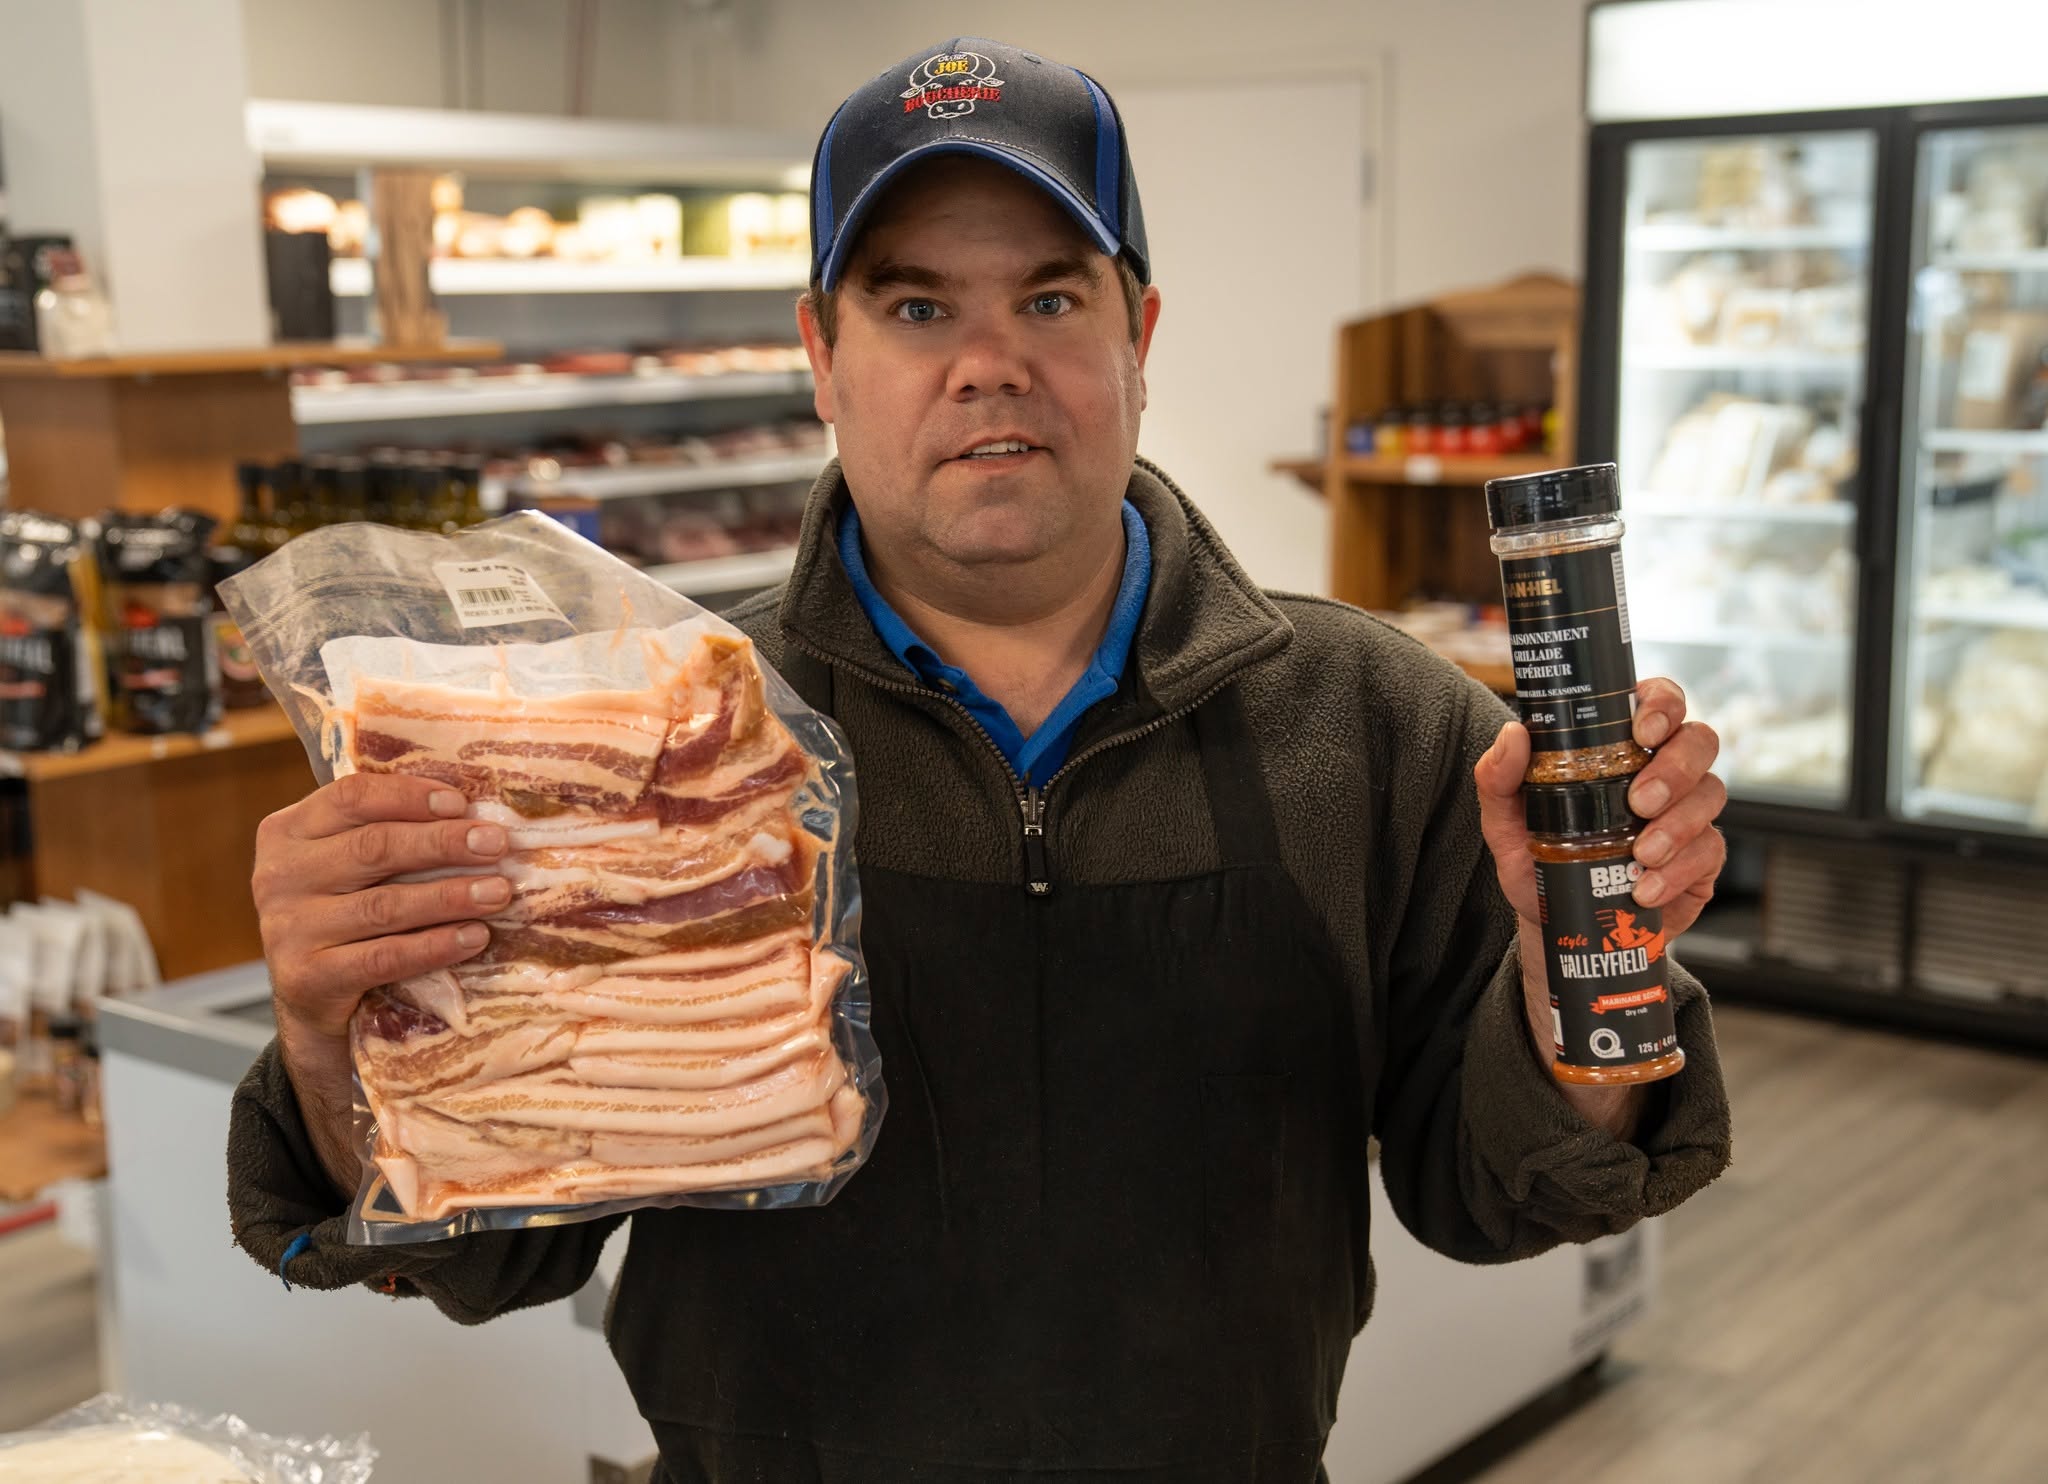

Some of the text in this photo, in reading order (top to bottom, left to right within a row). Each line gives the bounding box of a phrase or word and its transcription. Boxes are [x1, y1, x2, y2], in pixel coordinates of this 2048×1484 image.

[934, 60, 969, 75] JOE
[904, 85, 1001, 113] BOUCHERIE
[1514, 647, 1563, 662] GRILLADE
[1515, 664, 1573, 679] SUPÉRIEUR
[1547, 684, 1592, 696] SEASONING
[1532, 712, 1544, 722] 125
[1557, 933, 1589, 950] style
[1559, 946, 1649, 979] VALLEYFIELD
[1601, 994, 1641, 1006] MARINADE
[1625, 1009, 1637, 1017] Dry
[1638, 1041, 1653, 1054] 125
